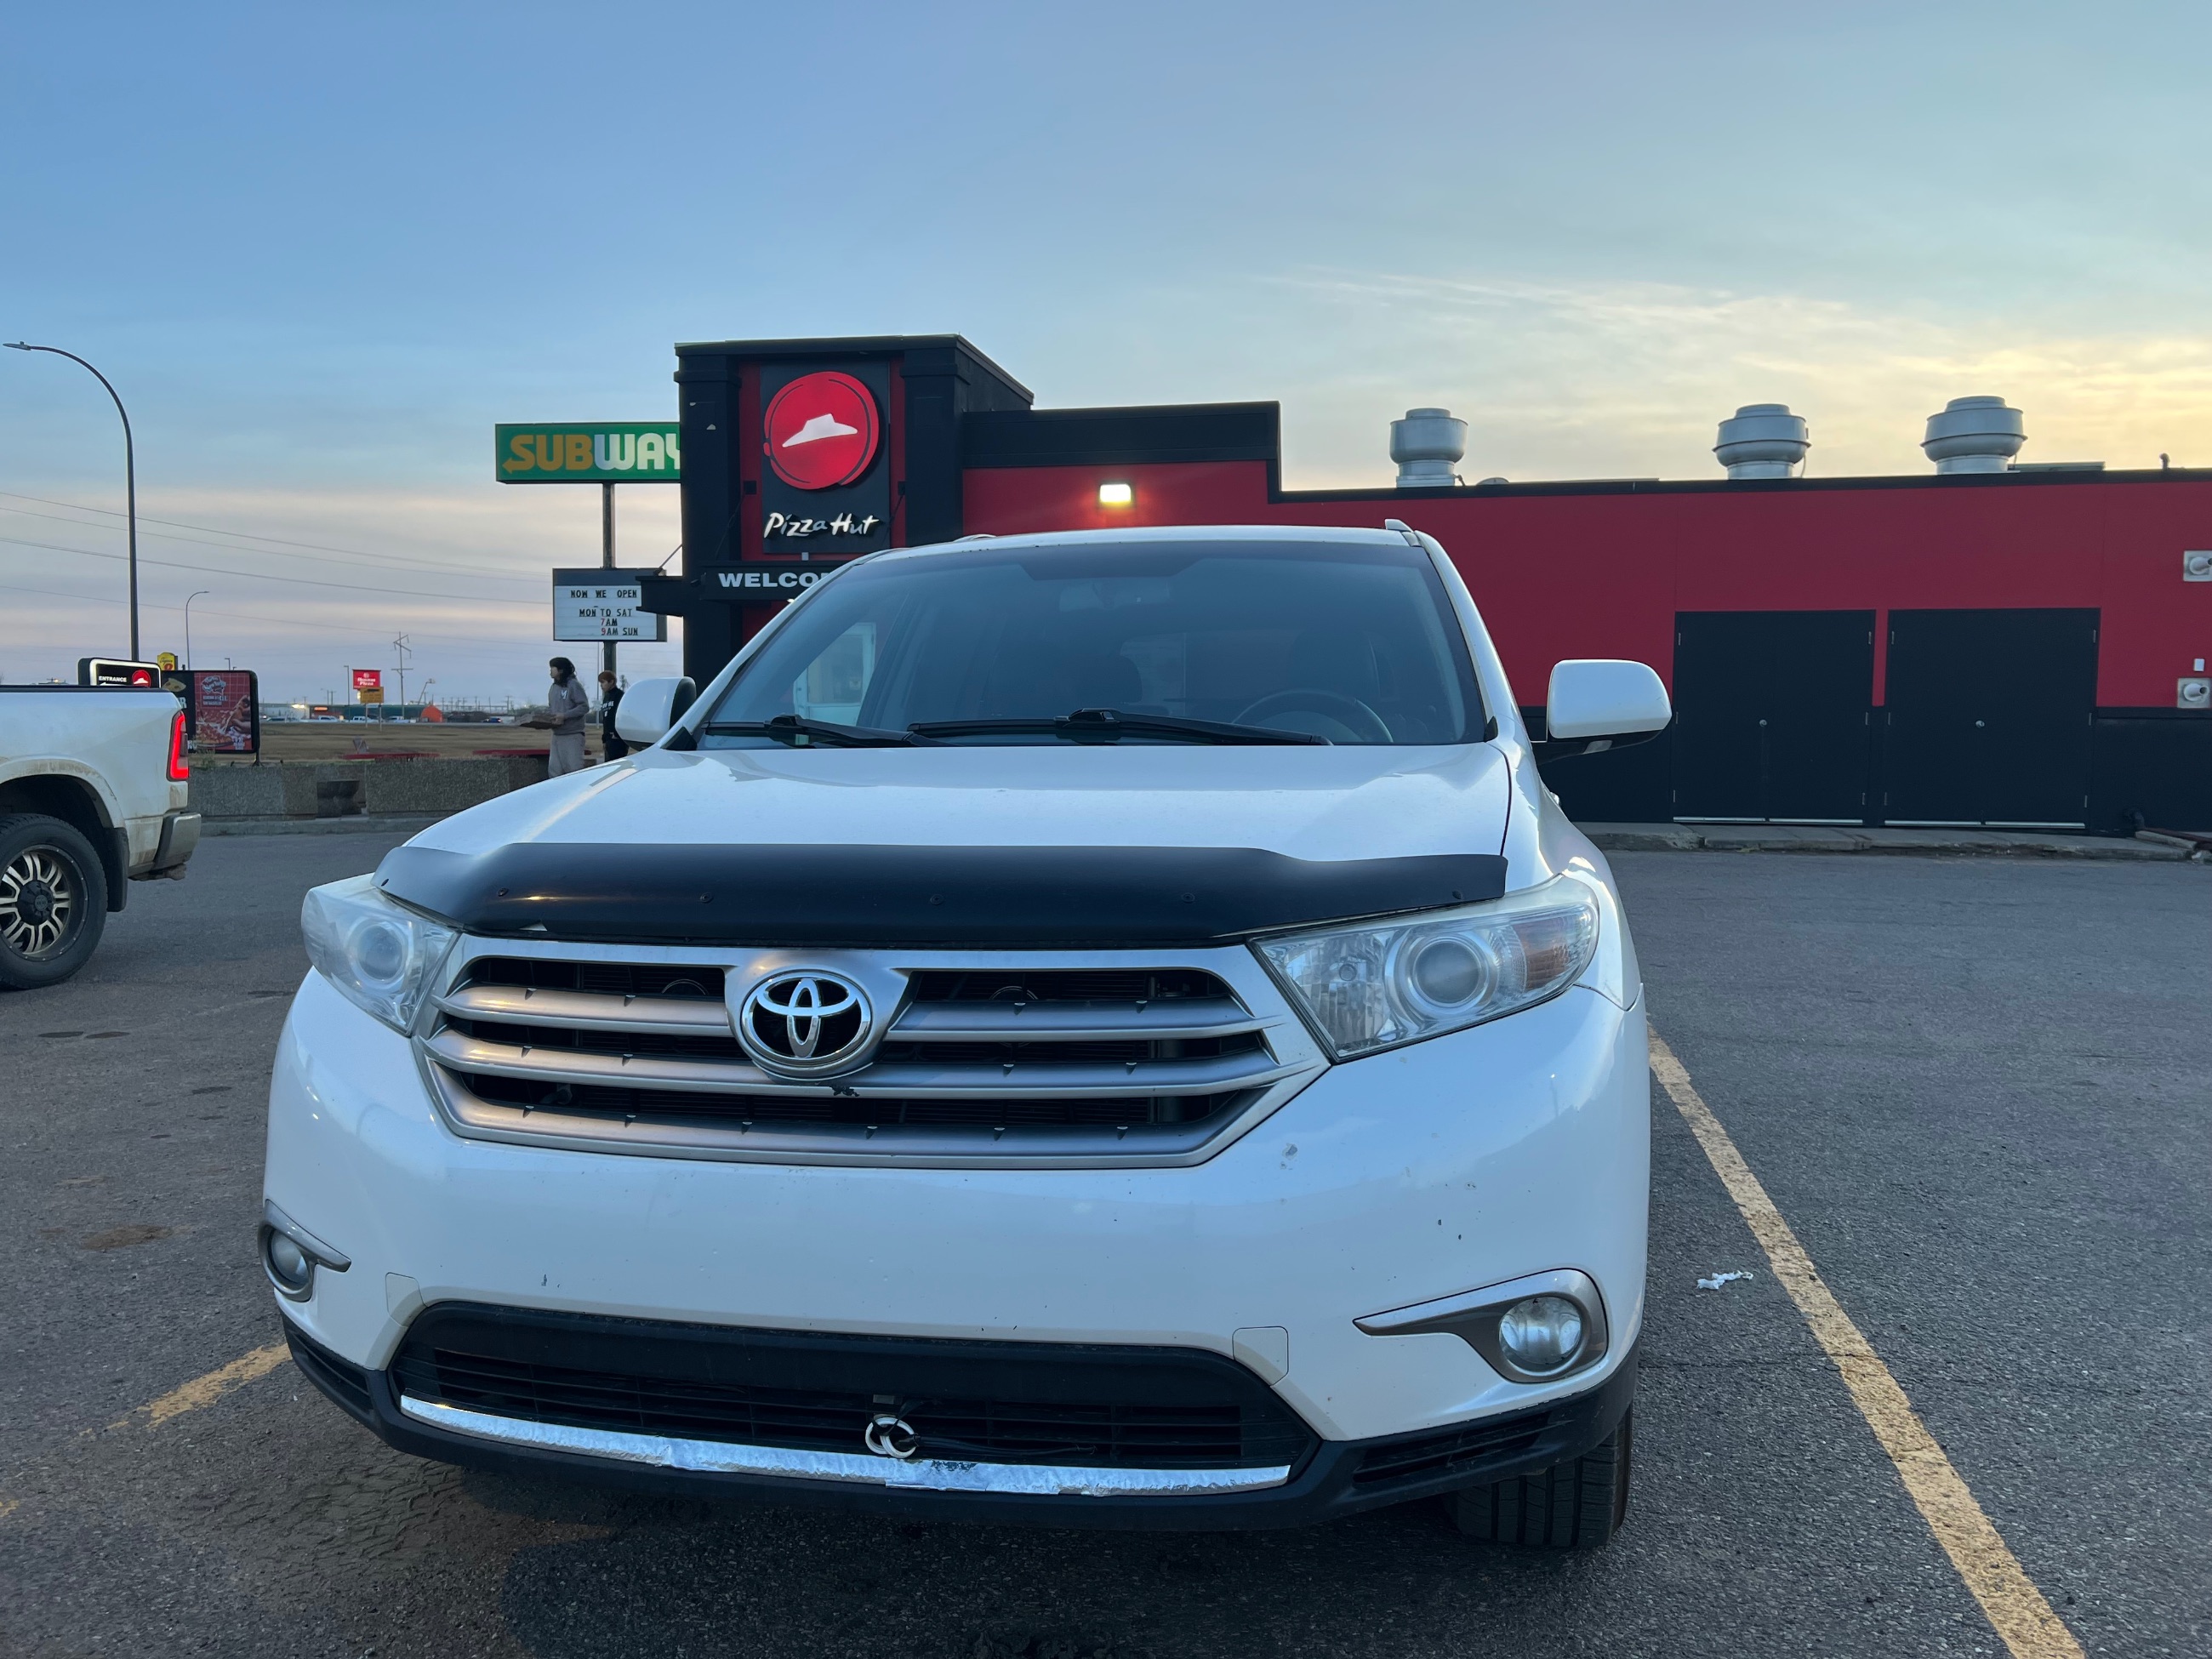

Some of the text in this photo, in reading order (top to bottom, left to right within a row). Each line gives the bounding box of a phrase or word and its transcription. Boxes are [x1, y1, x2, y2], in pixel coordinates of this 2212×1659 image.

[763, 511, 880, 539] Pizza Hut
[571, 590, 637, 598] NOW WE OPEN
[579, 608, 632, 617] MON TO SAT
[601, 627, 619, 636] 9AM
